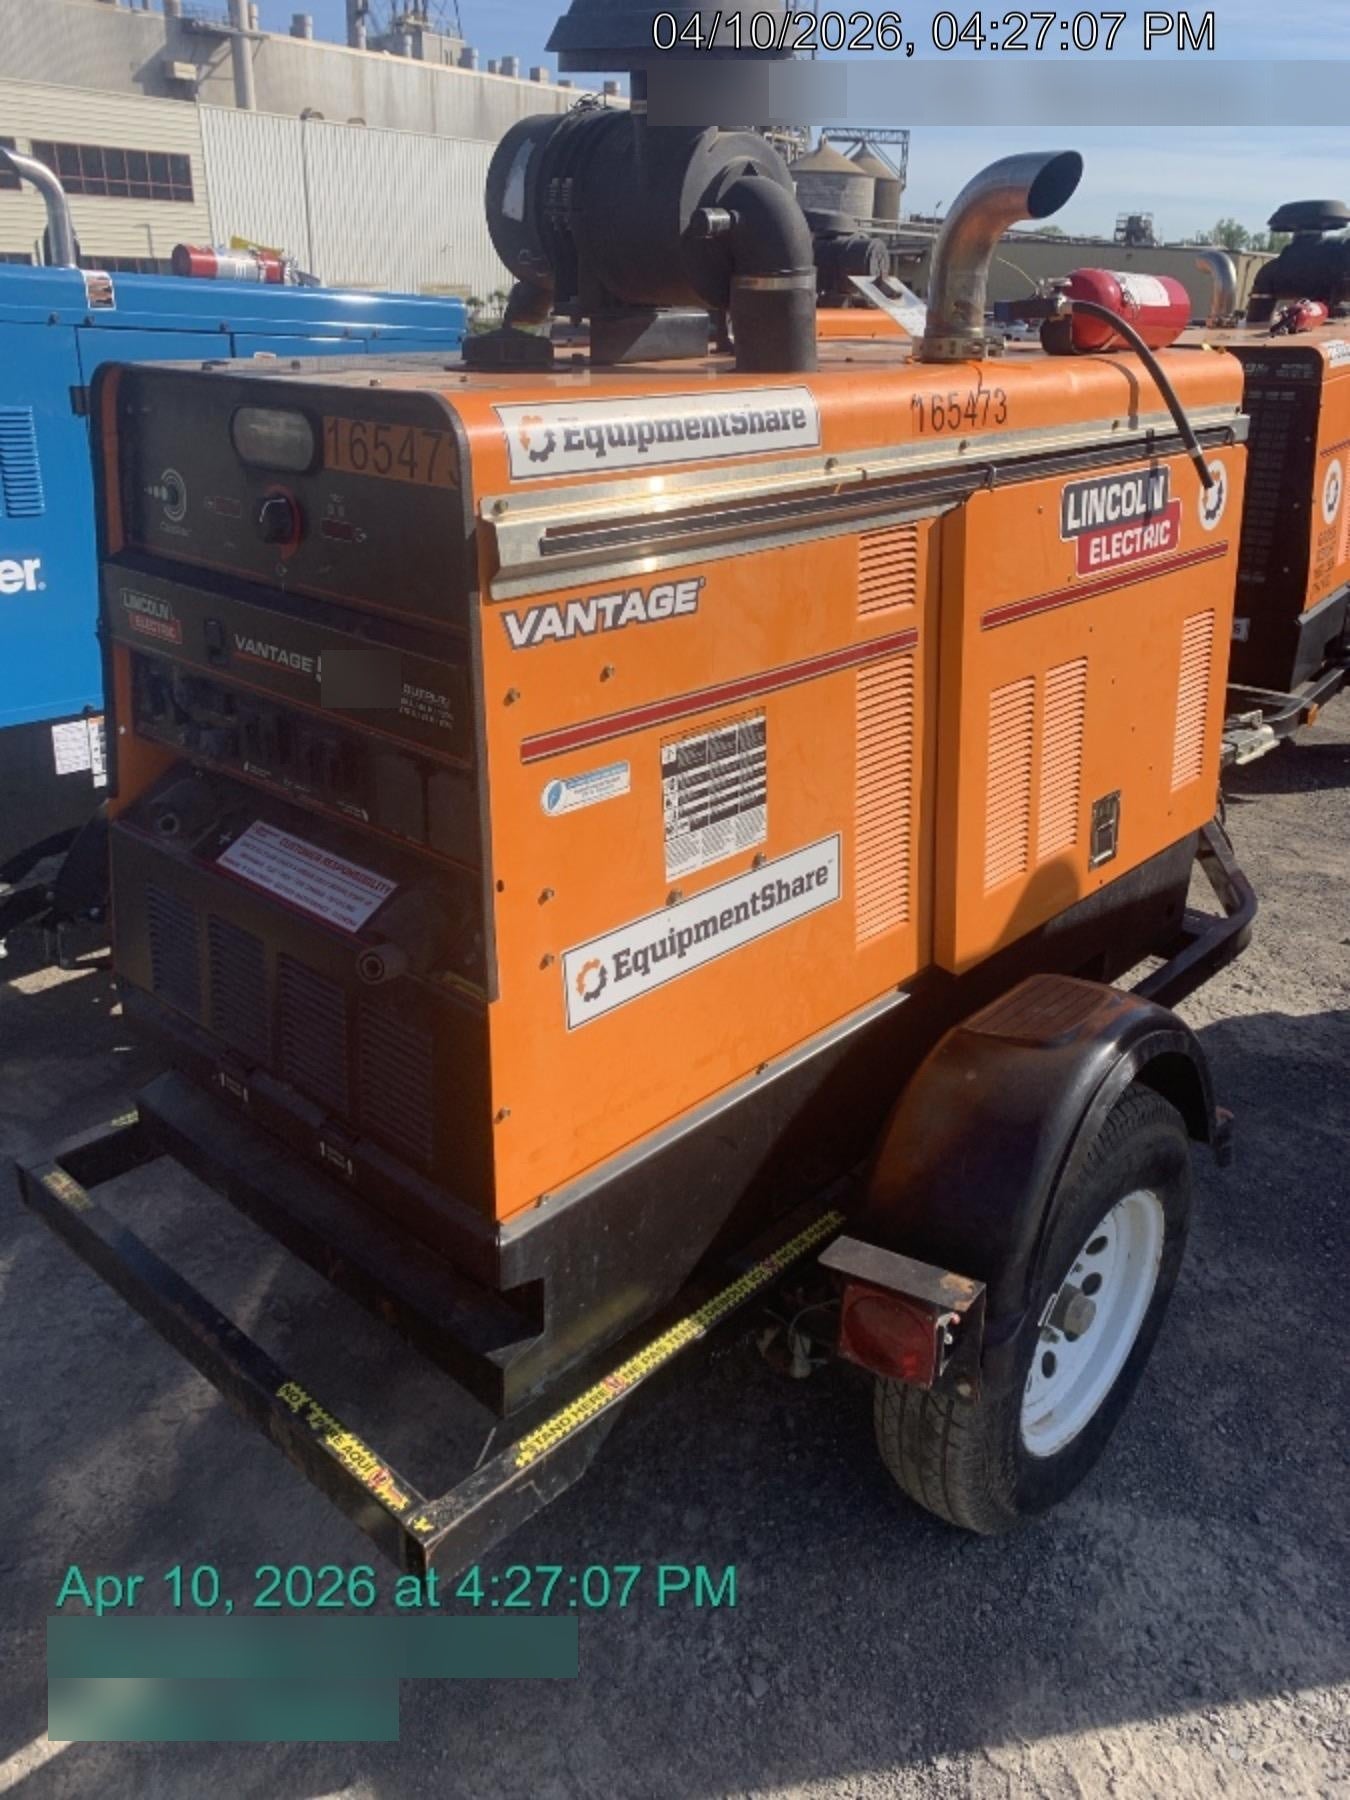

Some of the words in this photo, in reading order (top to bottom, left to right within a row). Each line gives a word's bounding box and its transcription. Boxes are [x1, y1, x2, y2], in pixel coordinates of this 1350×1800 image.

[563, 407, 808, 458] EquipmentShare
[910, 387, 1008, 433] 165473
[1066, 475, 1164, 531] LINCOLN
[1089, 519, 1171, 565] ELECTRIC
[502, 578, 700, 648] VANTAGE
[233, 633, 315, 673] VANTAGE
[612, 863, 829, 984] EquipmentShare
